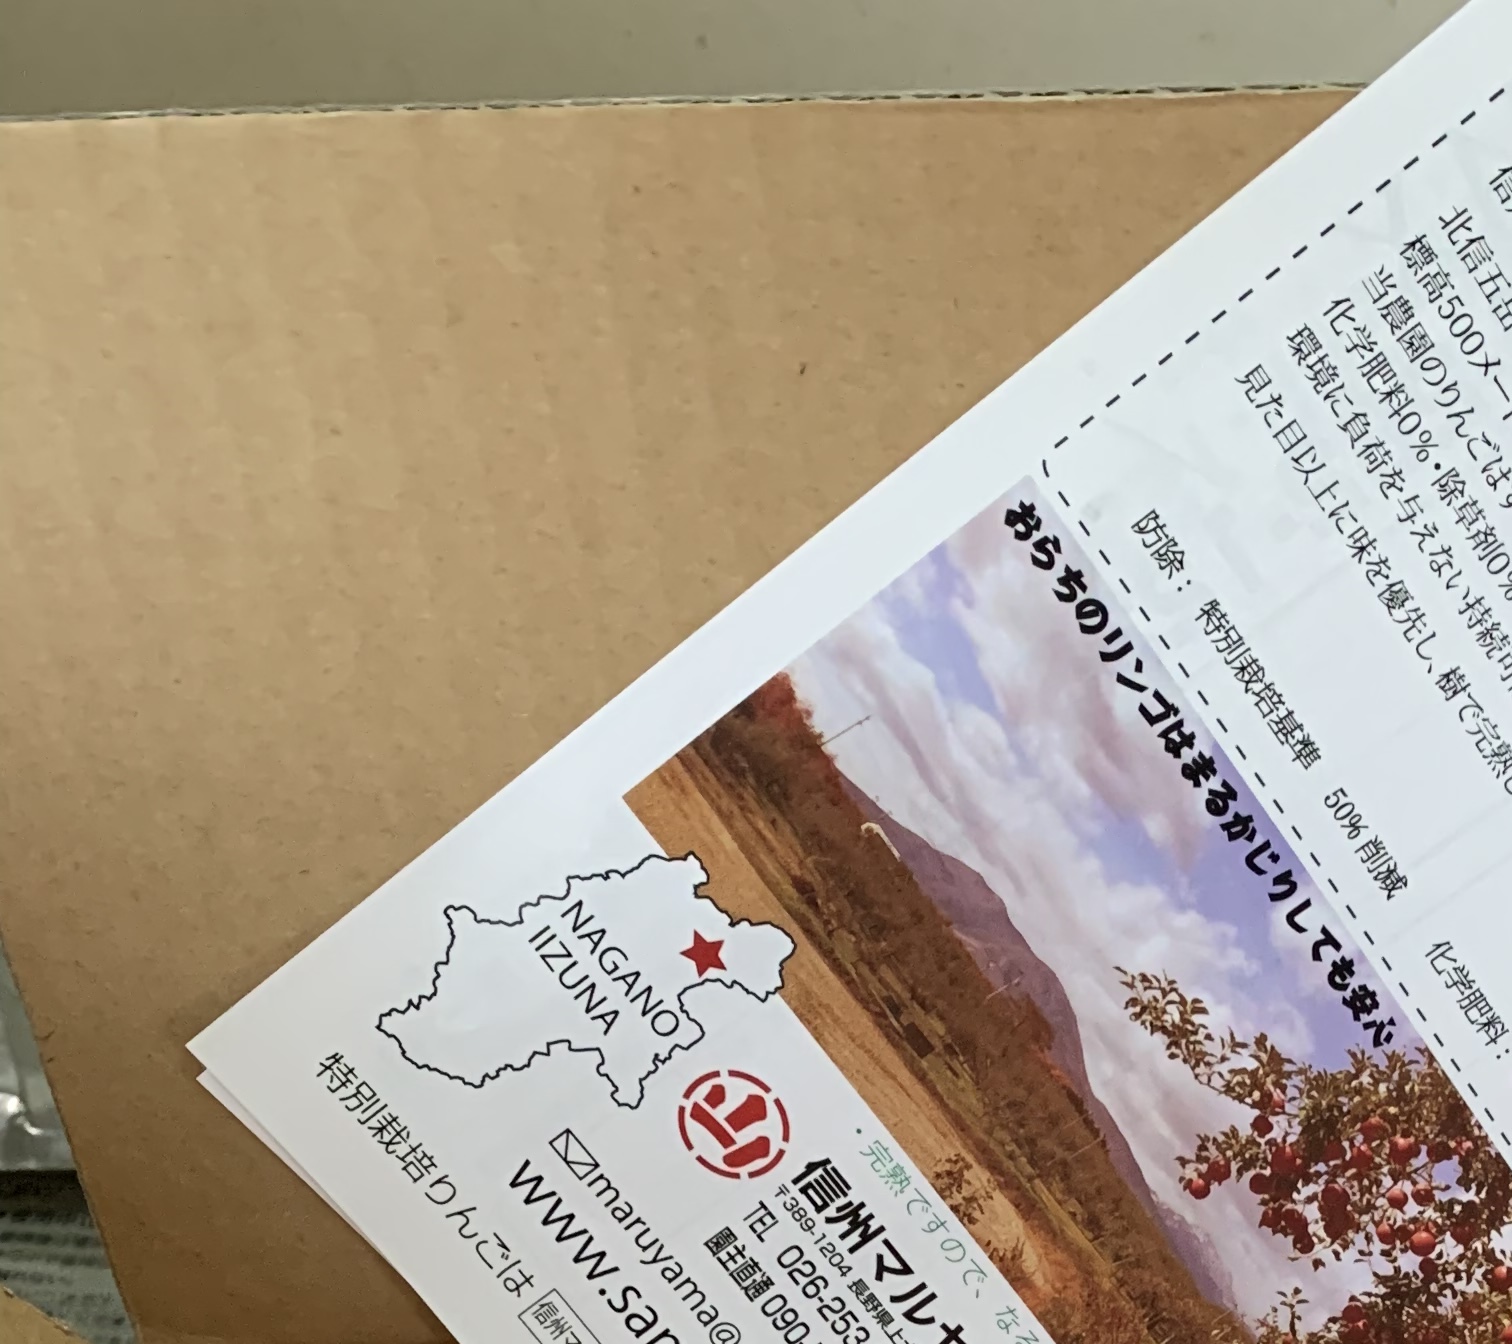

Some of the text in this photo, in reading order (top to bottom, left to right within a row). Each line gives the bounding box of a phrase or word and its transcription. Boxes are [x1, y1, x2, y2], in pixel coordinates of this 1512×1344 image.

[997, 492, 1406, 1054] おらちのリンゴはまるかじりしても安心
[528, 924, 619, 1035] IIZUNA
[560, 899, 679, 1036] NAGANO
[316, 1052, 534, 1297] 特別栽培りんごは
[743, 1199, 778, 1243] TEL
